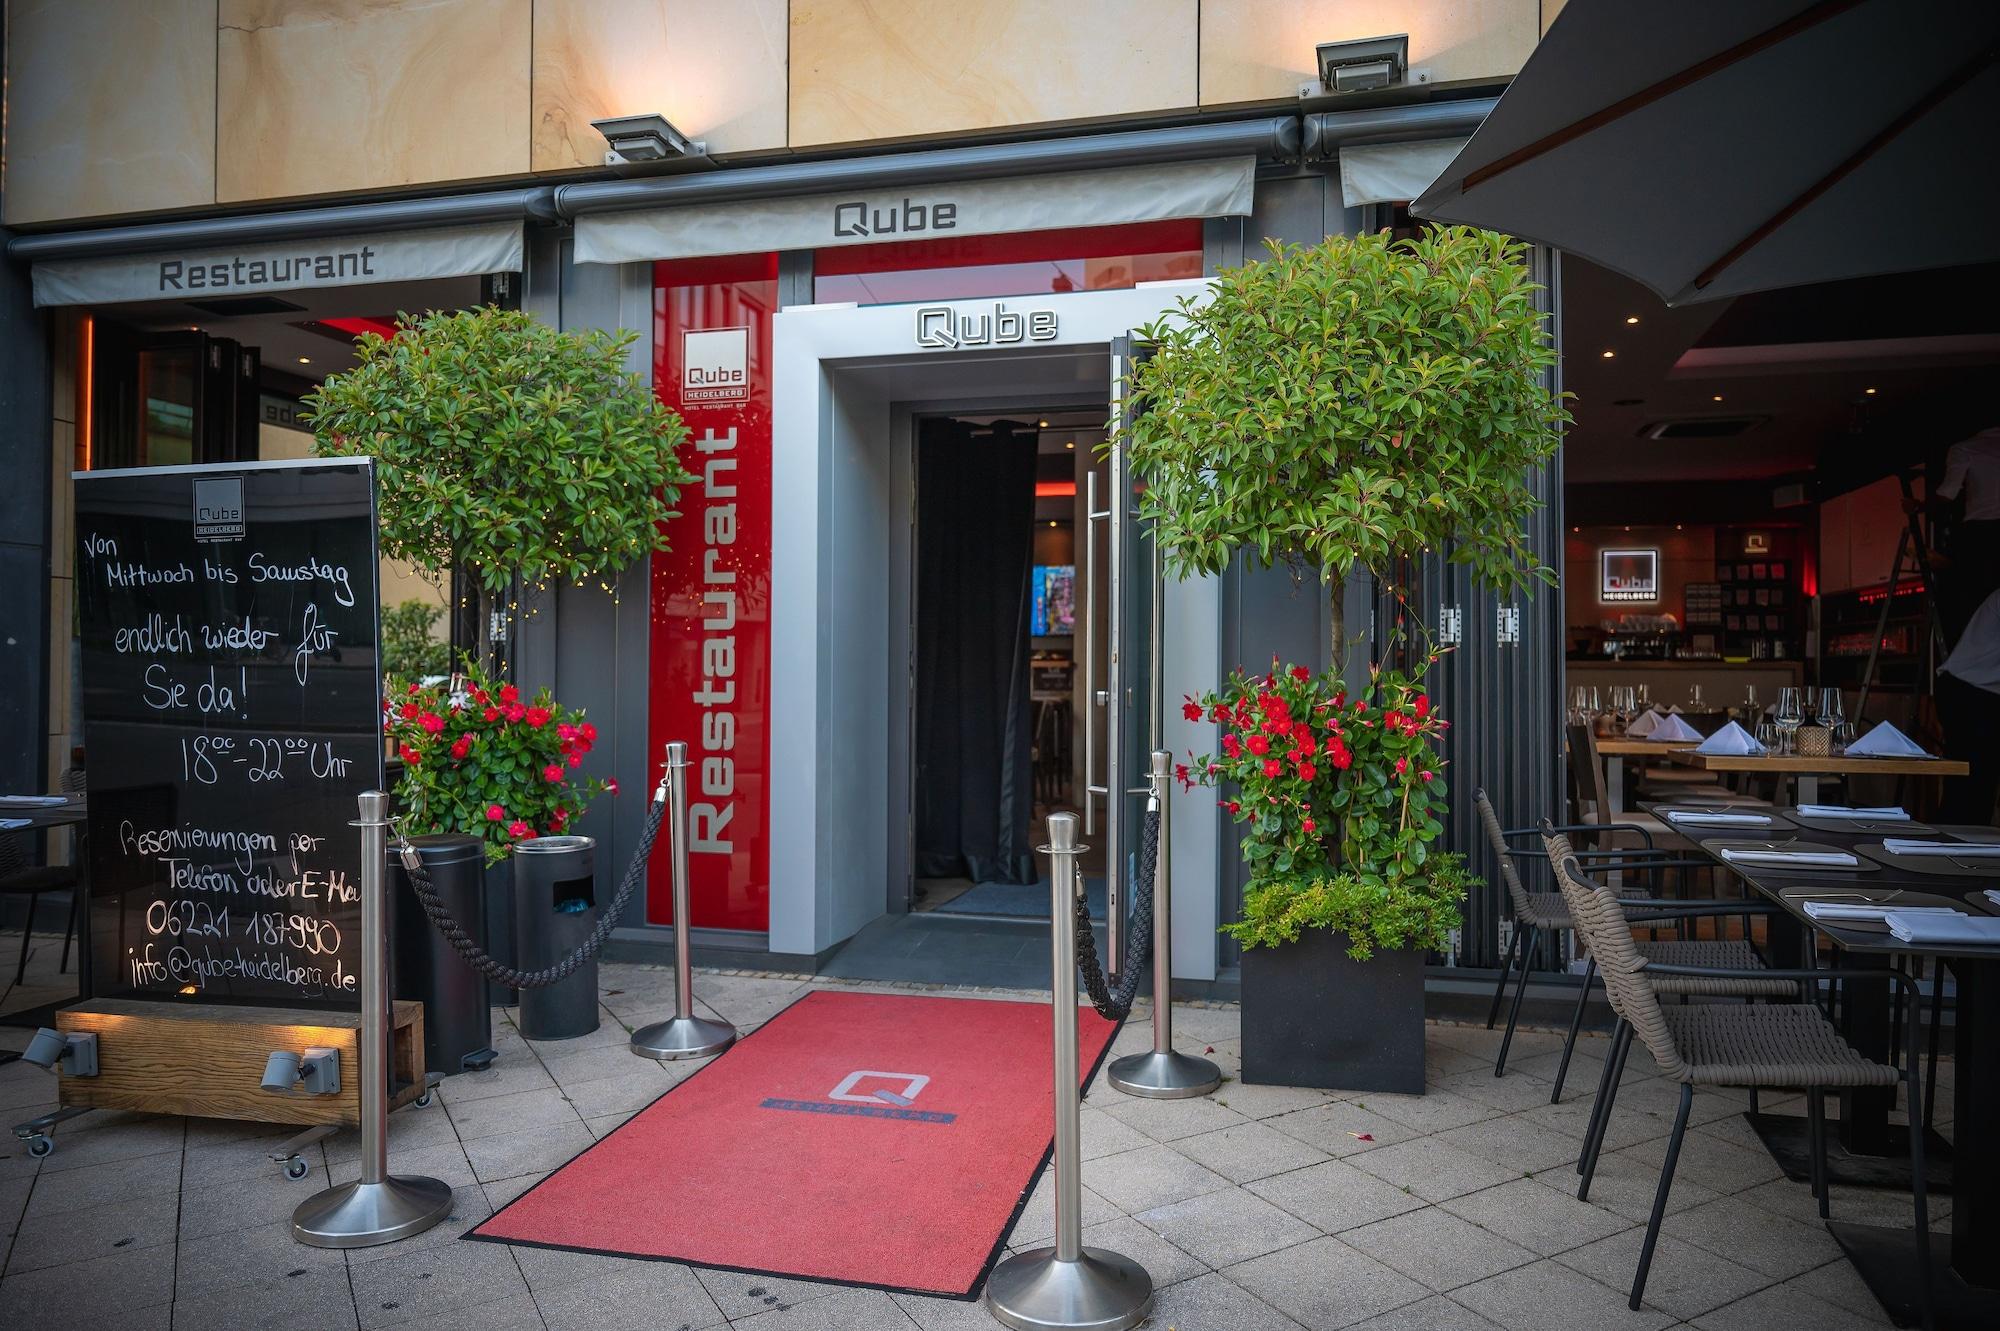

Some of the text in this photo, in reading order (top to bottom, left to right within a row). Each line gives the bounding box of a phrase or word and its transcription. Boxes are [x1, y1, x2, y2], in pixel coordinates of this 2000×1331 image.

[834, 198, 957, 238] Qube
[159, 246, 375, 291] Restaurant
[915, 301, 1058, 349] Qube
[687, 389, 744, 399] HEIDELBERG
[689, 366, 743, 385] Qube
[199, 506, 239, 521] Qube
[106, 552, 355, 607] Mittwoch bis Samstag
[1607, 575, 1653, 590] Qube
[115, 612, 192, 654] endlich
[201, 615, 279, 650] wieder
[688, 426, 738, 855] Restaurant
[143, 664, 248, 720] Sie da!
[310, 741, 353, 779] Uhr
[288, 831, 326, 876] per
[158, 857, 239, 894] Telefon
[247, 866, 298, 899] oder
[146, 900, 342, 955] 06221 187990
[827, 1070, 930, 1106] Q
